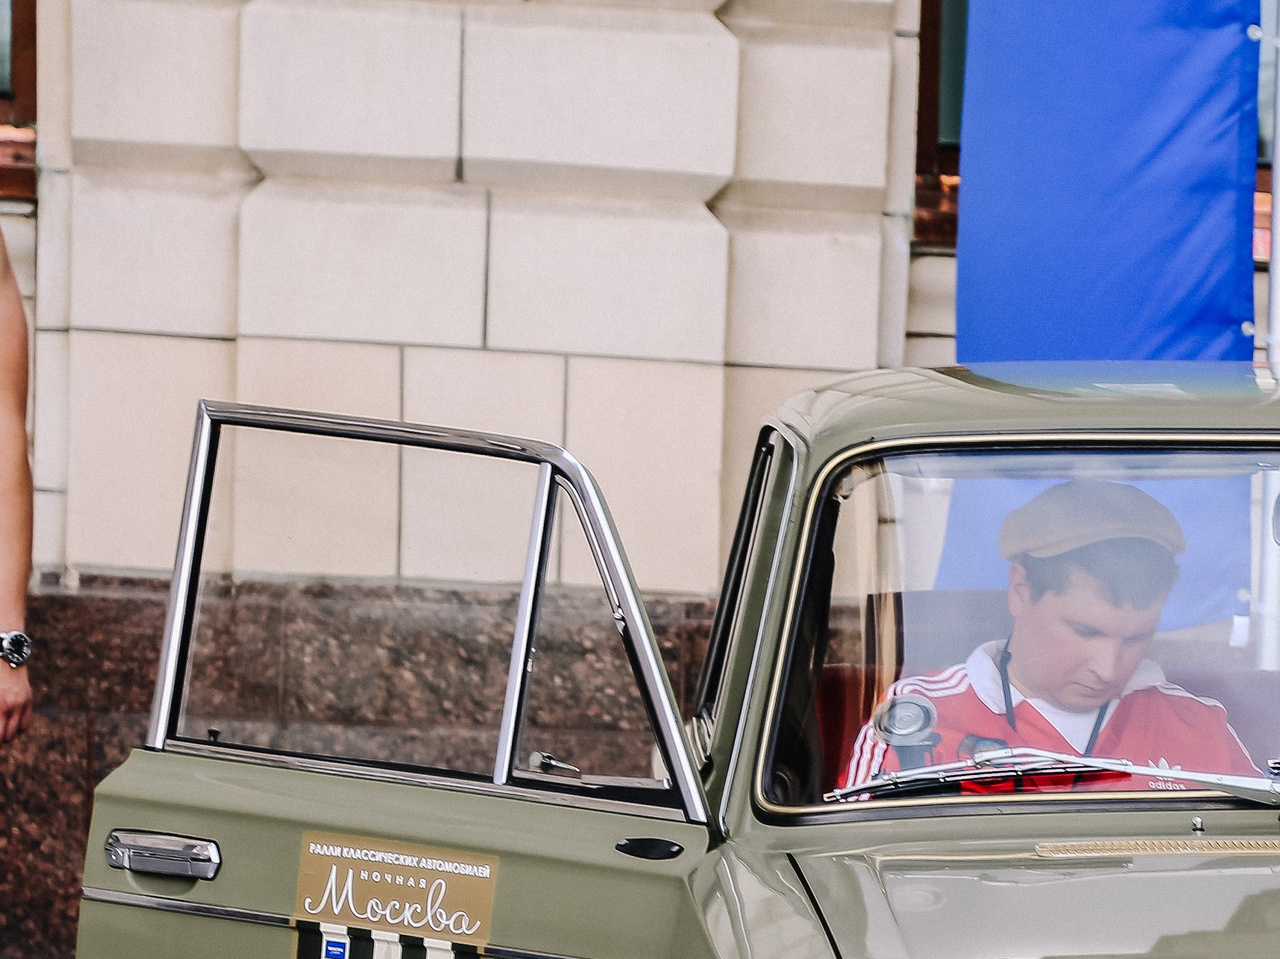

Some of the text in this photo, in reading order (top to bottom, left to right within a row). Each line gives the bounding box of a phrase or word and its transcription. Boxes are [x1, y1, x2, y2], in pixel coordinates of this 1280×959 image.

[1147, 780, 1187, 790] adidas
[308, 842, 491, 879] РАЛЛИ КЛАССИЧЕСКИХ АВТОМОБИЛЕЙ
[359, 869, 427, 889] НОЧНАЯ
[303, 863, 482, 935] Москва
